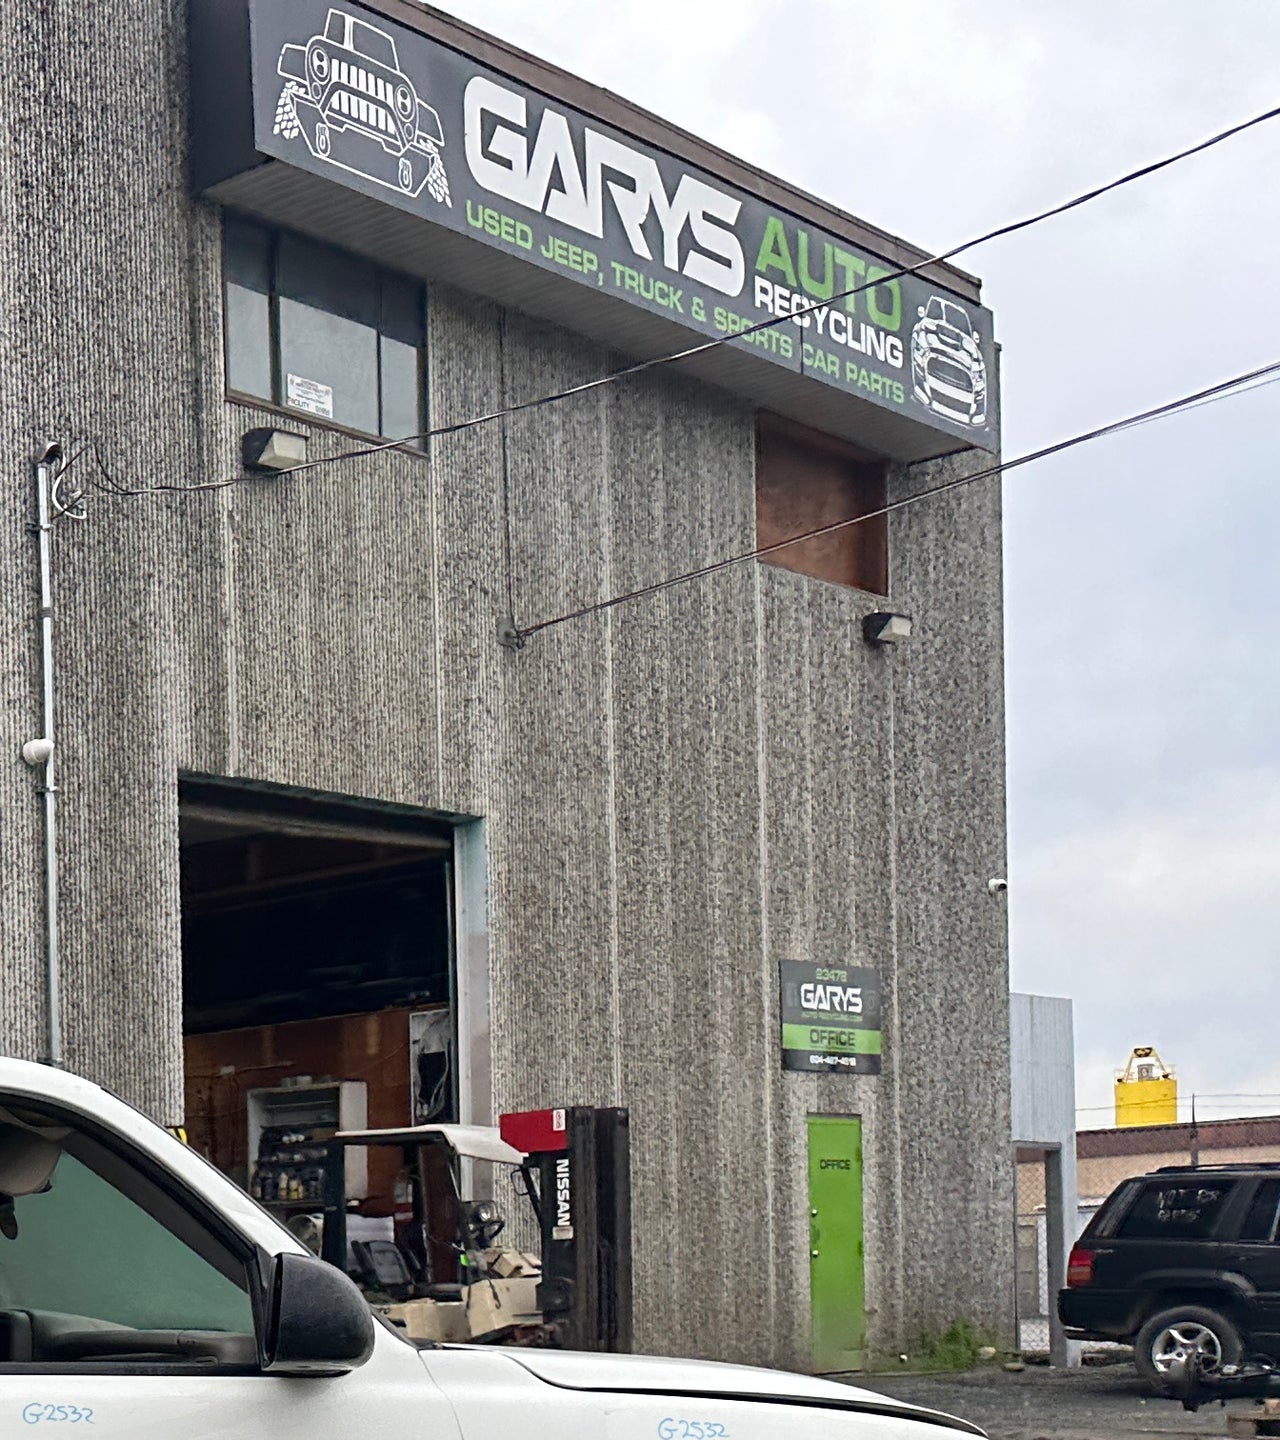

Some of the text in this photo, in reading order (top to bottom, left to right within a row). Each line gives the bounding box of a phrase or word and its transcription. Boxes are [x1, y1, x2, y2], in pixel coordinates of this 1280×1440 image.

[464, 76, 902, 332] GARYS AUTO
[466, 200, 905, 404] USED JEEP, TRUCK & SPORTS CAR PARTS
[753, 274, 904, 369] RECYCLING
[800, 983, 863, 1014] GARYS
[809, 1028, 856, 1047] OFFICE
[819, 1158, 851, 1170] OFFICE
[555, 1158, 571, 1226] NISSAN
[22, 1402, 96, 1425] G2532
[657, 1417, 731, 1440] G2532
